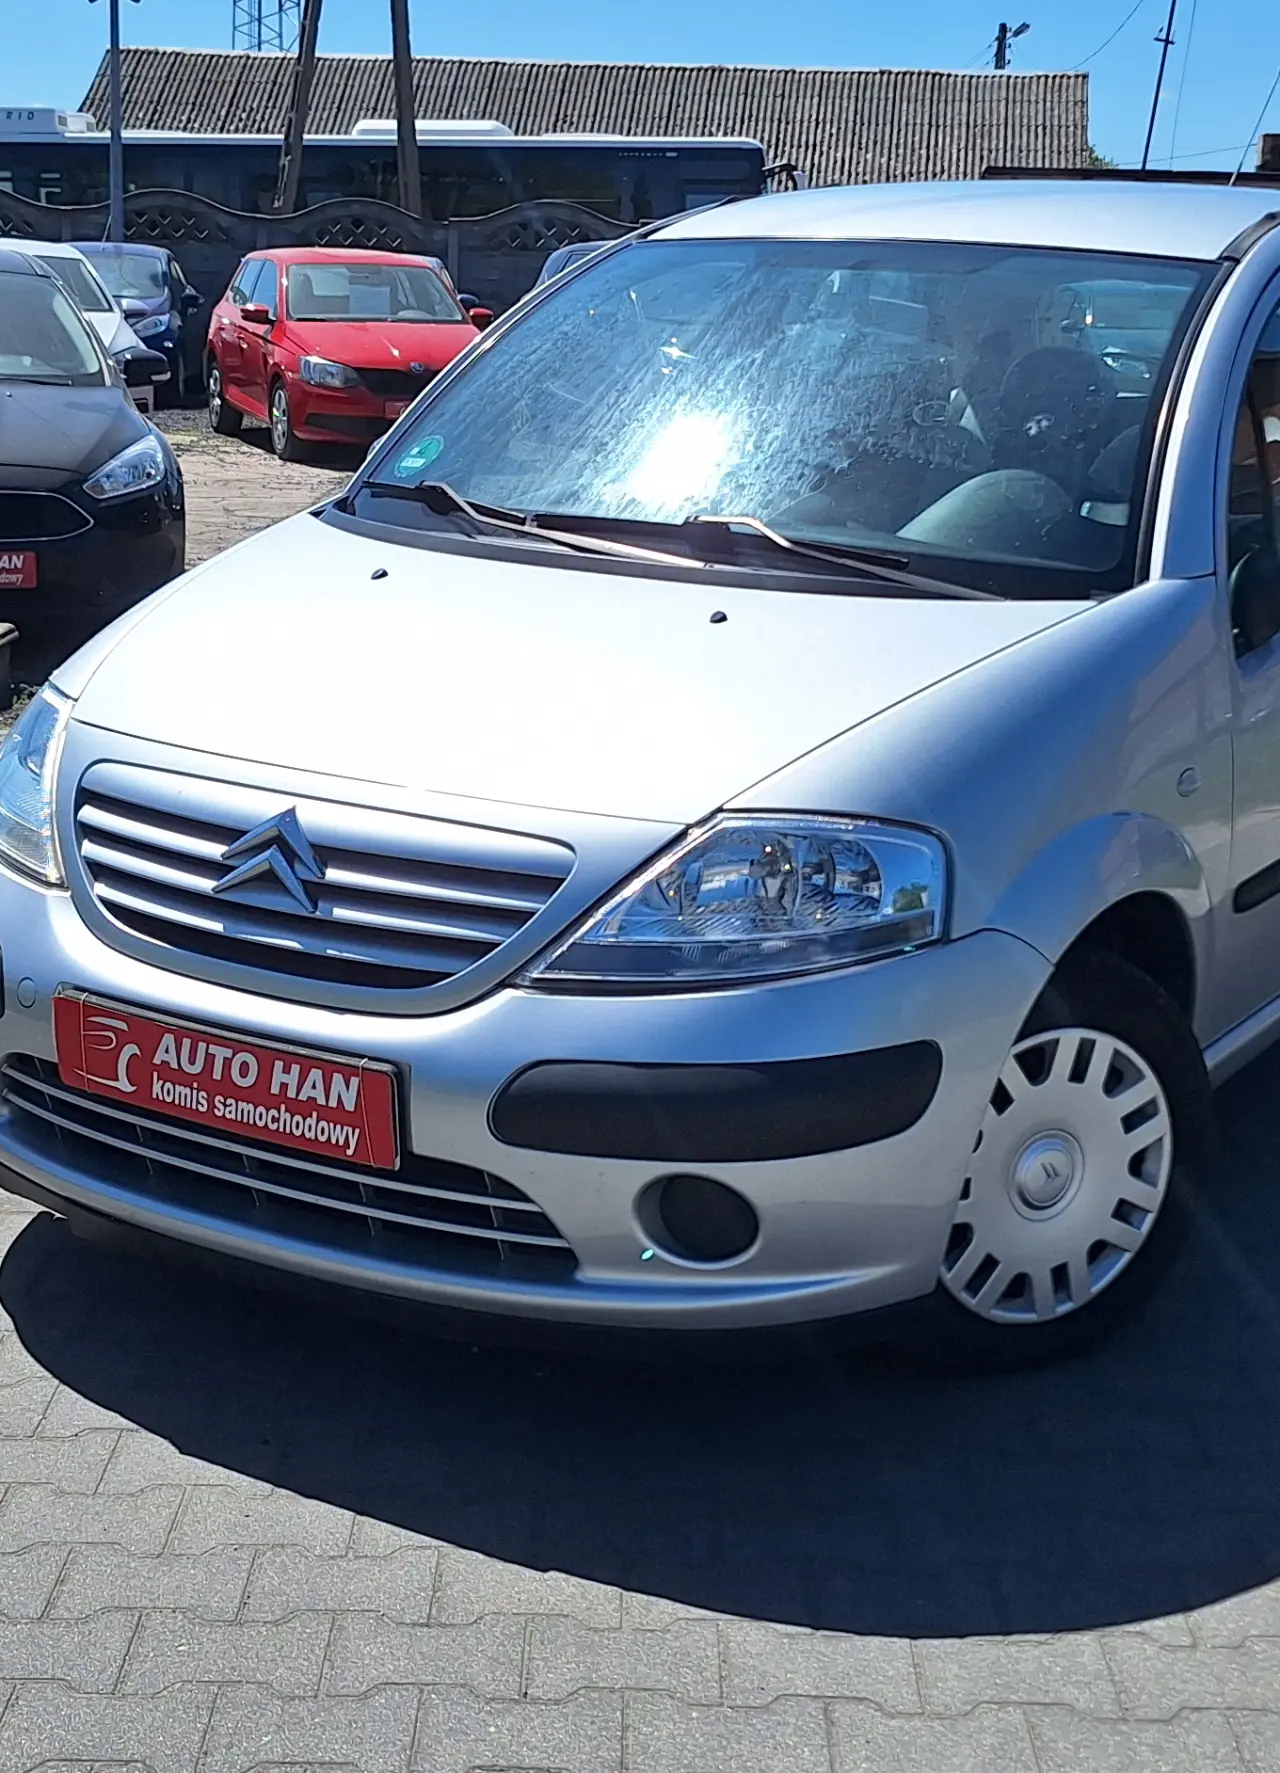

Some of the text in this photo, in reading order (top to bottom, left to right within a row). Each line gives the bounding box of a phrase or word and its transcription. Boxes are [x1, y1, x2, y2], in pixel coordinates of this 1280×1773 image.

[151, 1071, 360, 1156] komis samochodowy
[152, 1033, 360, 1112] AUTO HAN
